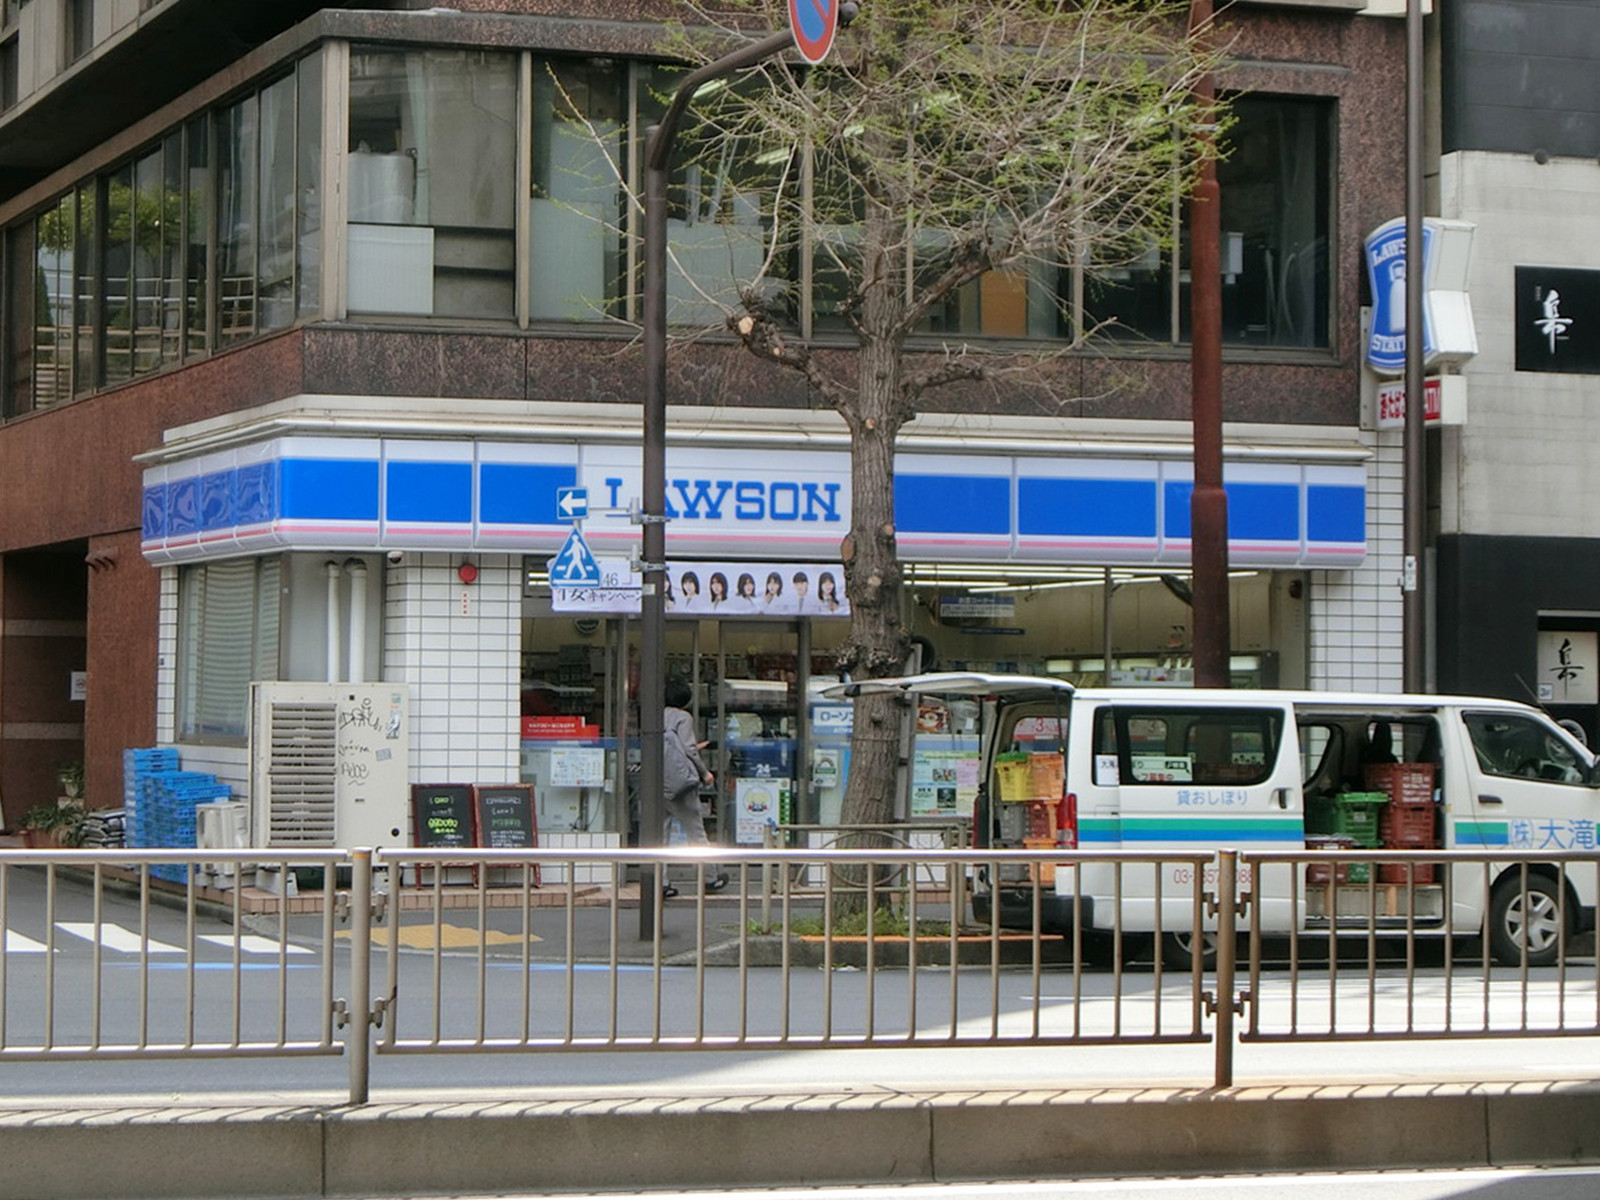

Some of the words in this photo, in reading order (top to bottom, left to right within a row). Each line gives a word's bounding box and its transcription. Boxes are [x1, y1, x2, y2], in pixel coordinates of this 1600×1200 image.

[603, 573, 619, 586] 46
[1176, 790, 1248, 805] 貸おしぼり
